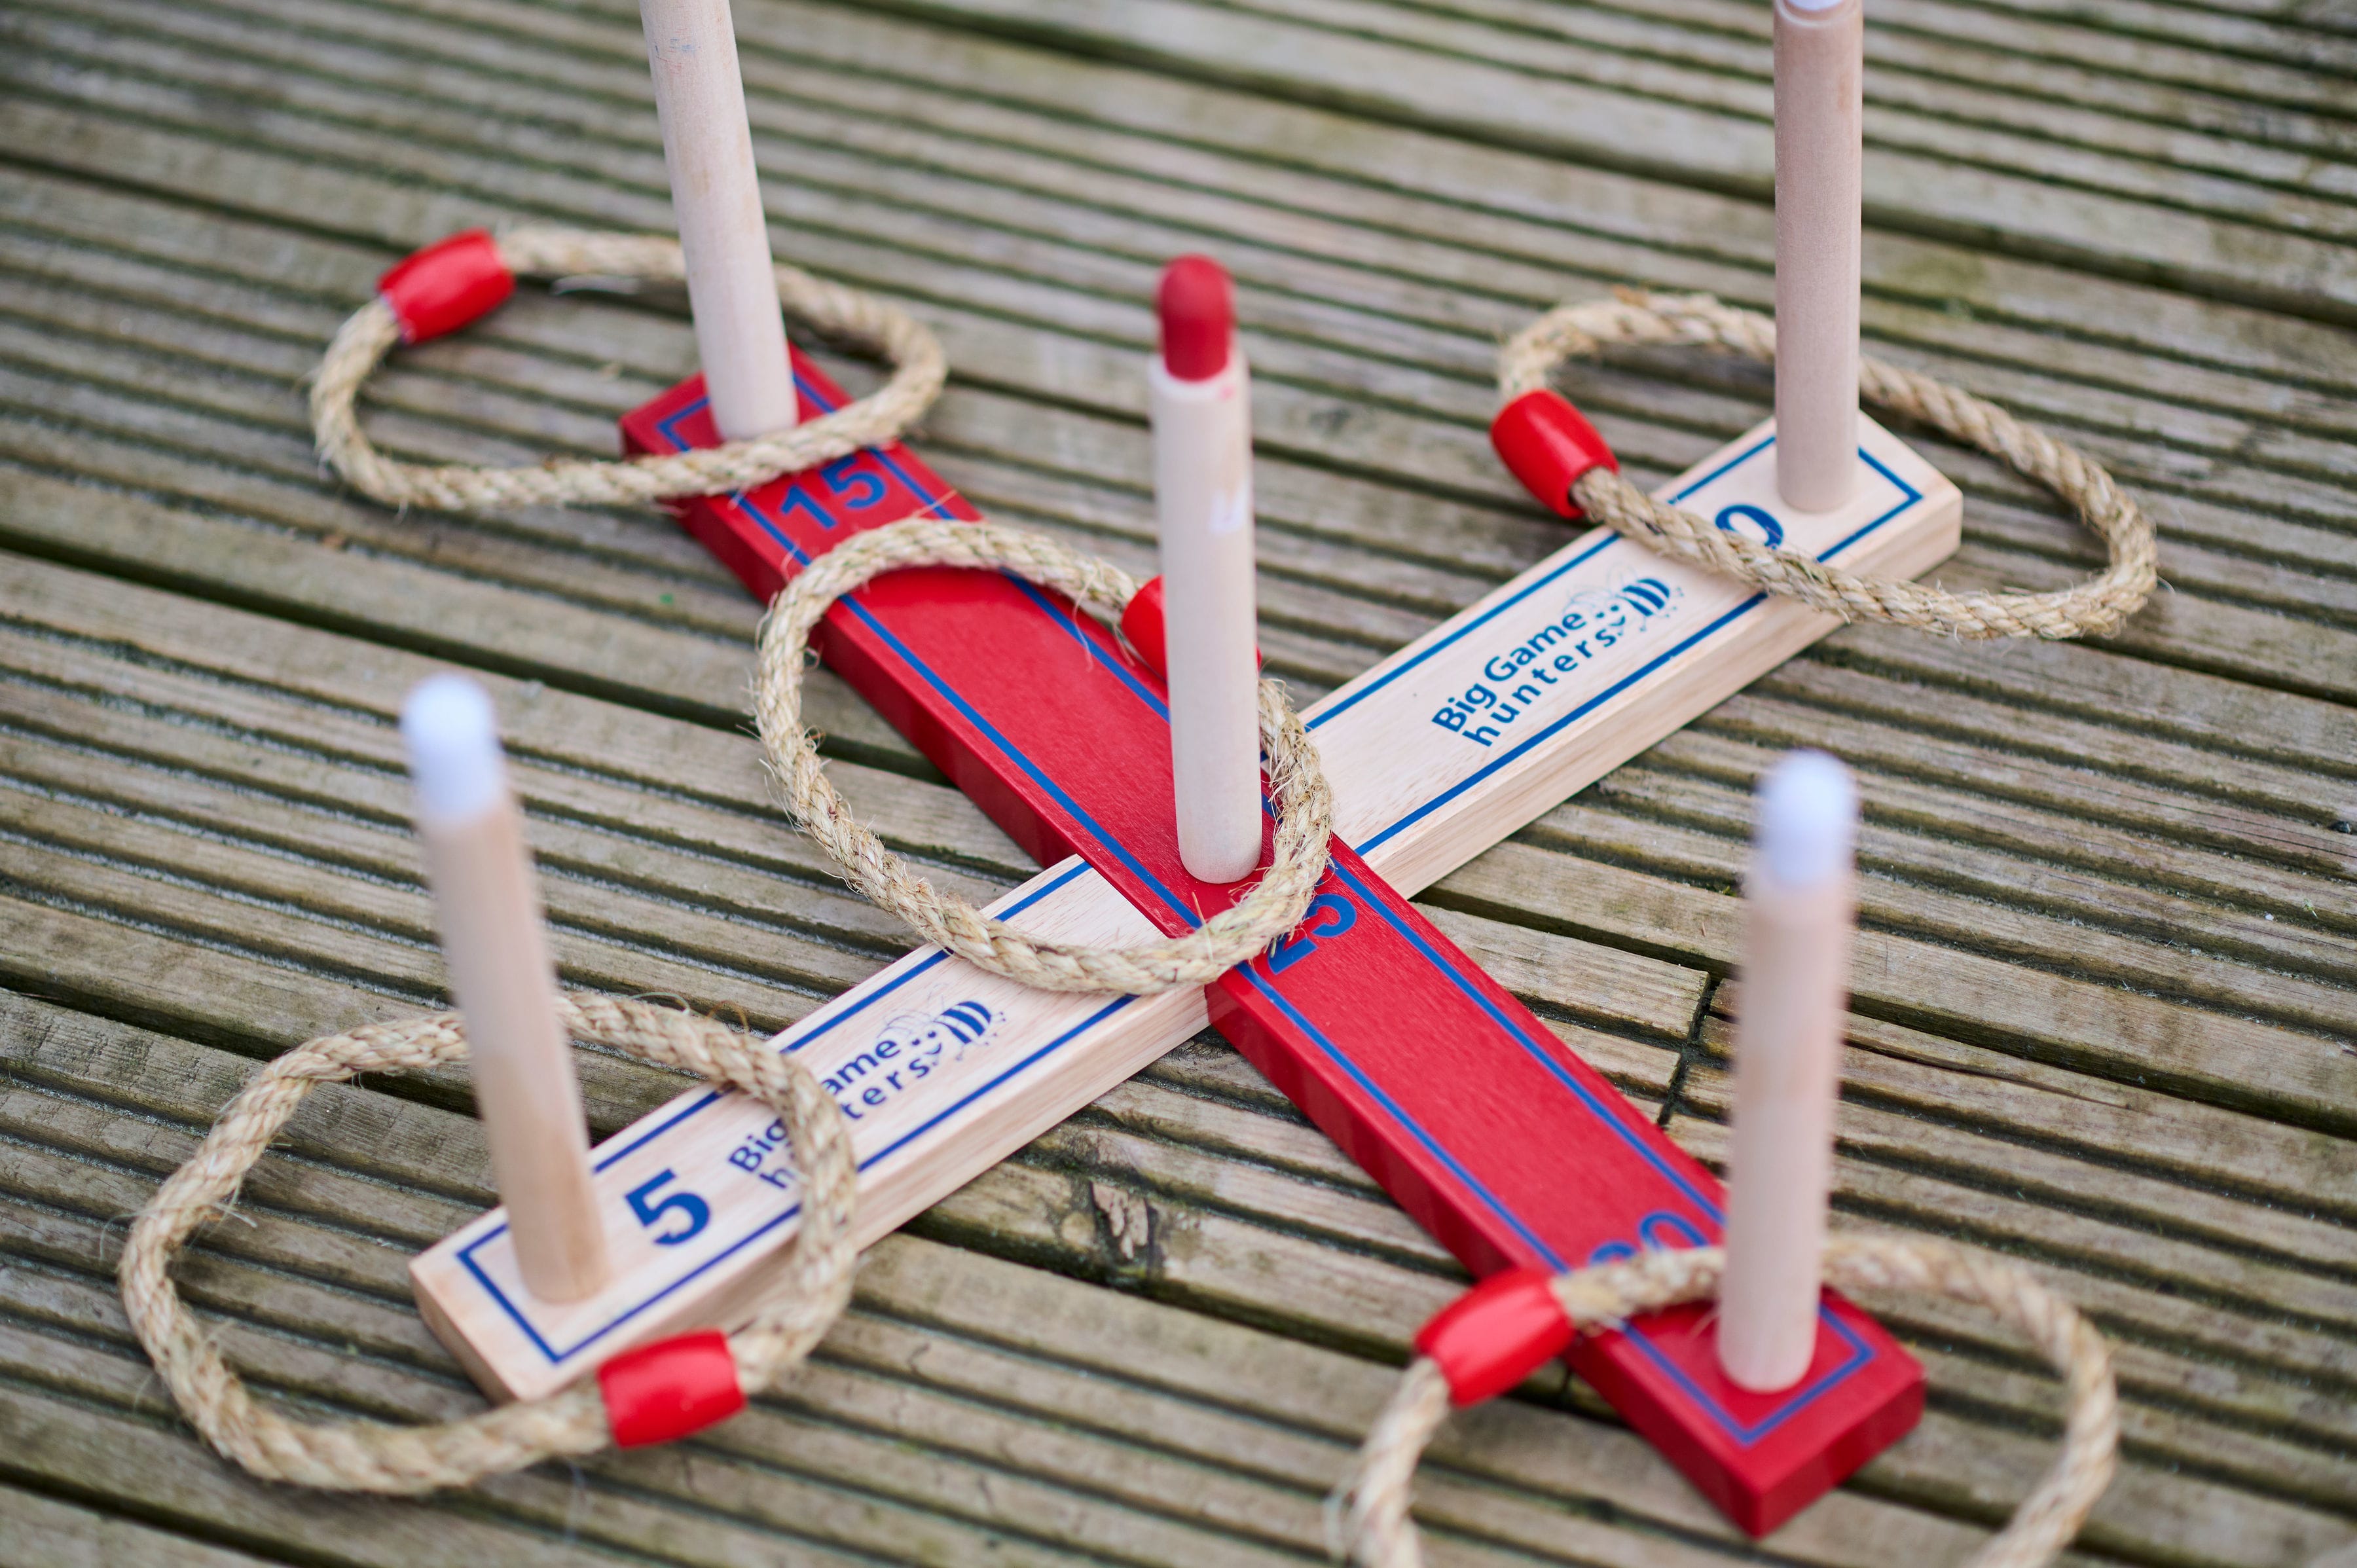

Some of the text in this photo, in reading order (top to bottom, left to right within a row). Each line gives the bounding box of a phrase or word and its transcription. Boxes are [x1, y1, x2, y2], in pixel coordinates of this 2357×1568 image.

[782, 454, 886, 530] 15
[1431, 613, 1587, 733] Big Game
[1461, 629, 1617, 747] hunters
[729, 1040, 901, 1172] Big ame
[759, 1058, 930, 1188] hters
[624, 1168, 711, 1245] 5
